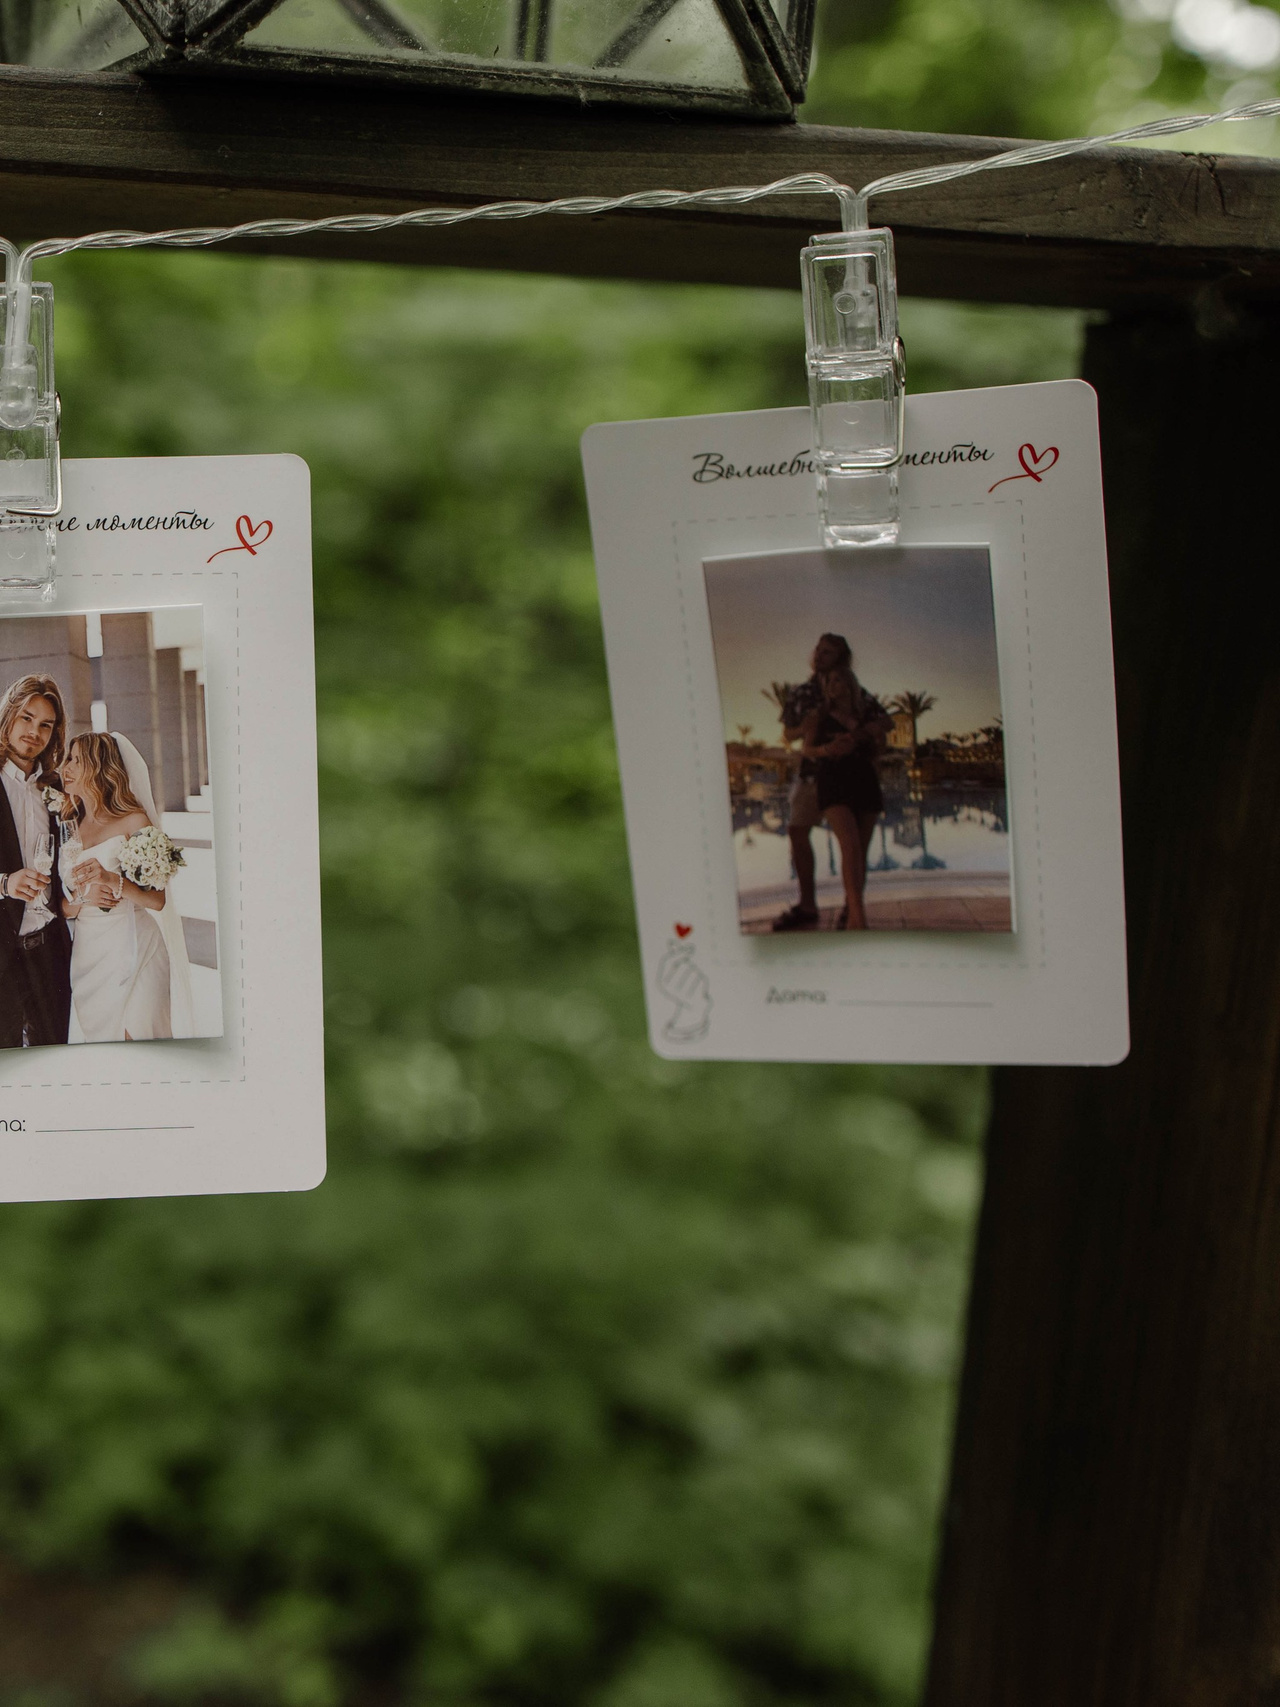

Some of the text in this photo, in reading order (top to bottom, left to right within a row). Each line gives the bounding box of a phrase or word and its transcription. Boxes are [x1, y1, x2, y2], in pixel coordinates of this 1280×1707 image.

[692, 441, 995, 483] Волшебн менты
[86, 508, 216, 532] моменты
